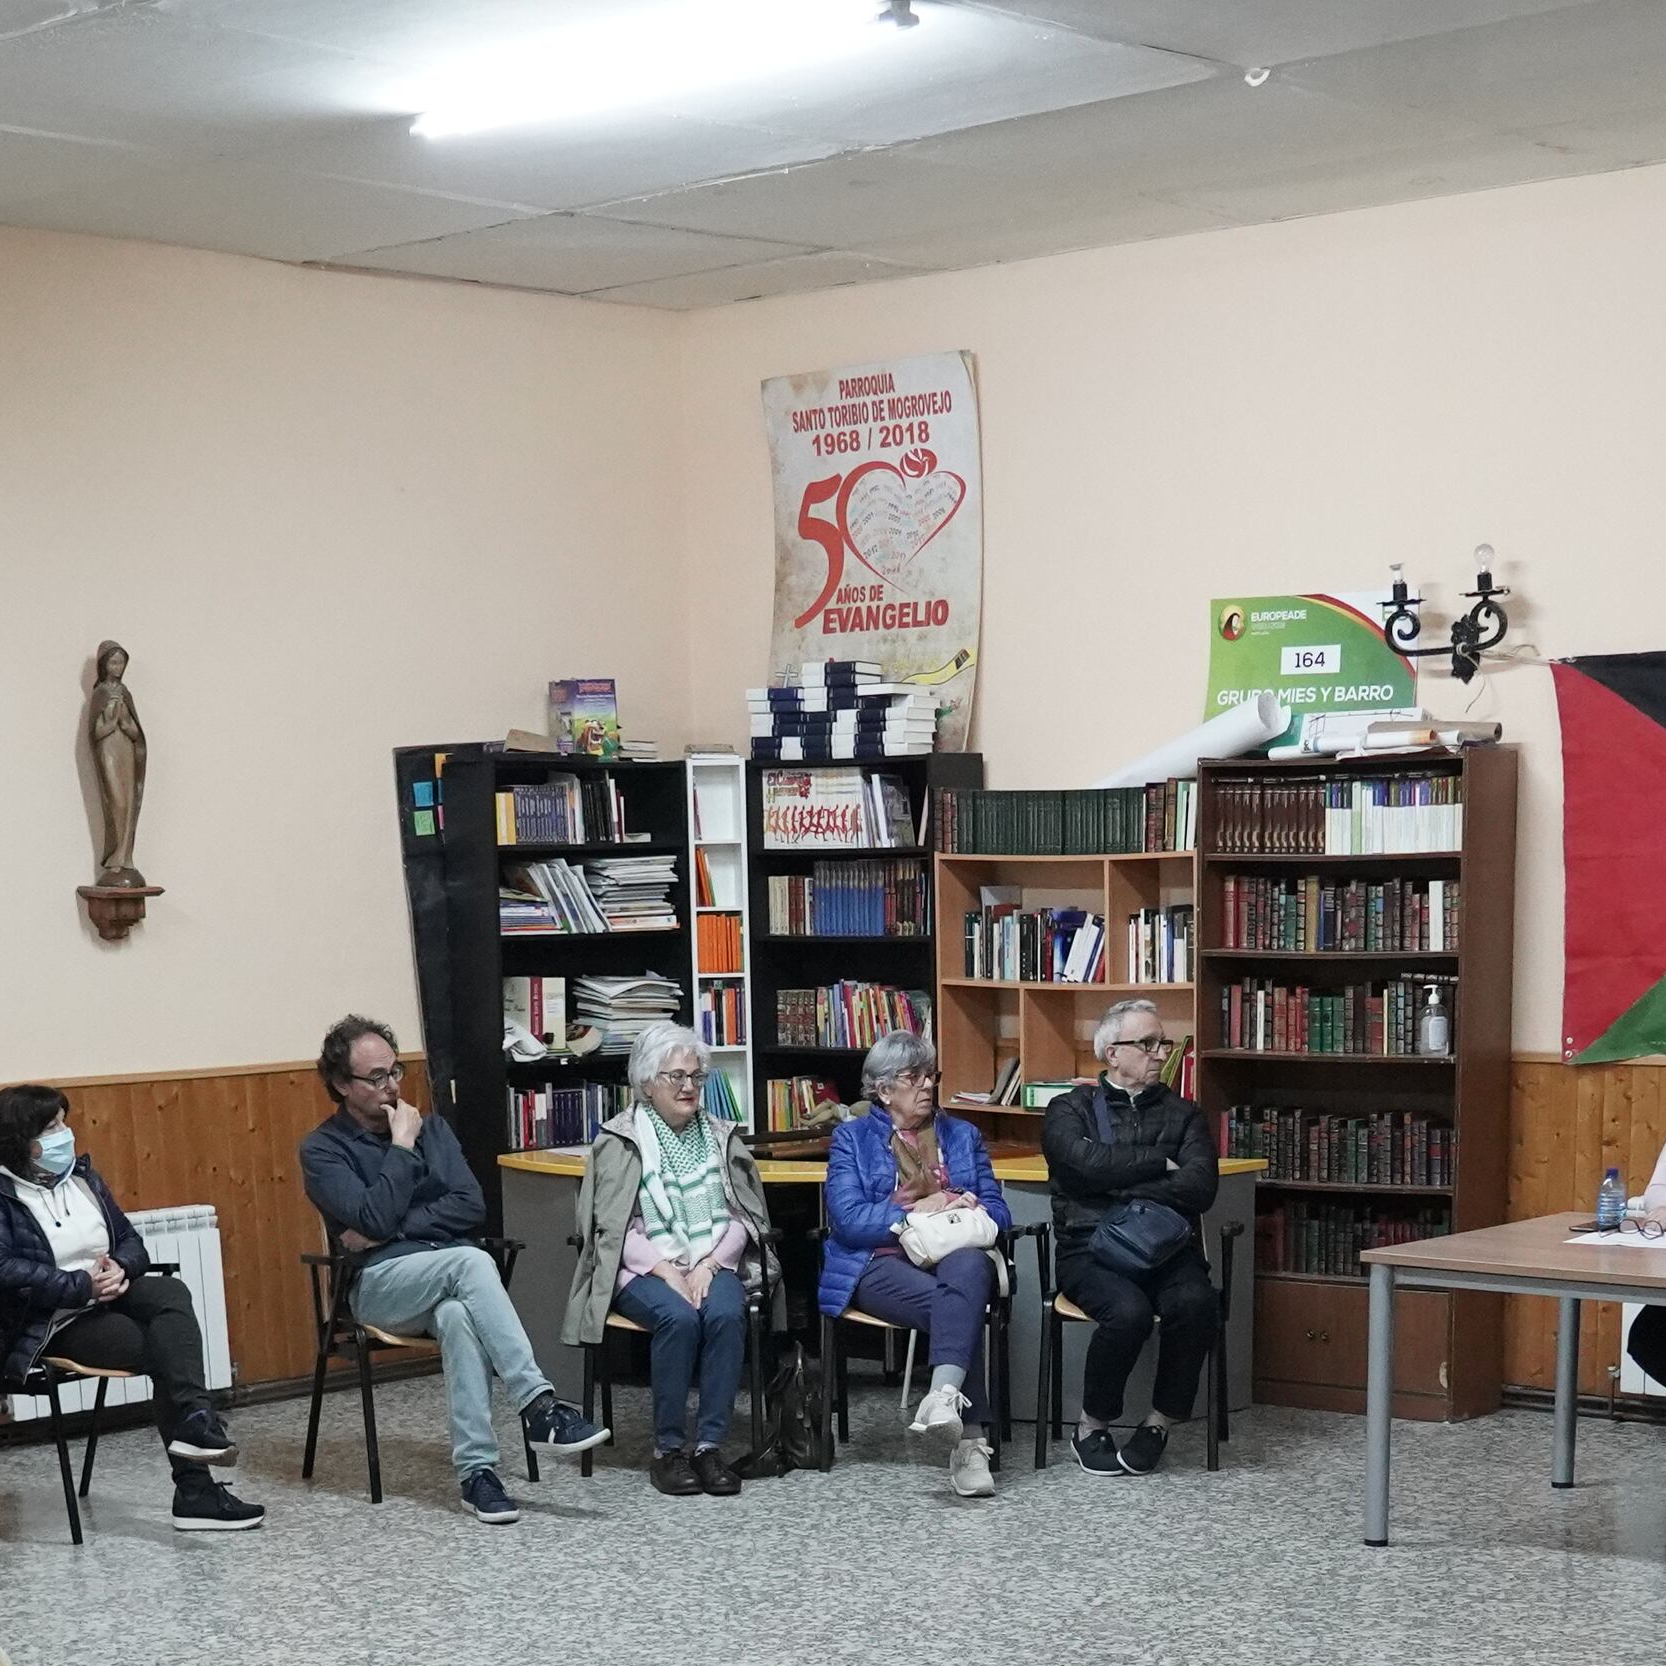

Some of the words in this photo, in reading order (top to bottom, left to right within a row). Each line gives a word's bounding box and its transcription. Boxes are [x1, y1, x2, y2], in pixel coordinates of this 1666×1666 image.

[839, 373, 895, 400] PARROQUIA
[792, 408, 826, 433] SANTO
[827, 402, 869, 428] TORIBIO
[872, 400, 885, 422] DE
[887, 390, 952, 420] MOGROVEJO
[812, 430, 861, 457] 1968
[879, 420, 930, 448] 2018
[836, 584, 866, 605] AÑOS
[869, 584, 884, 602] DE
[822, 599, 949, 635] EVANGELIO
[1251, 609, 1308, 622] EUROPEADE
[1294, 652, 1325, 669] 164
[1277, 687, 1317, 704] MIES
[1320, 686, 1332, 703] Y
[1334, 684, 1394, 702] BARRO
